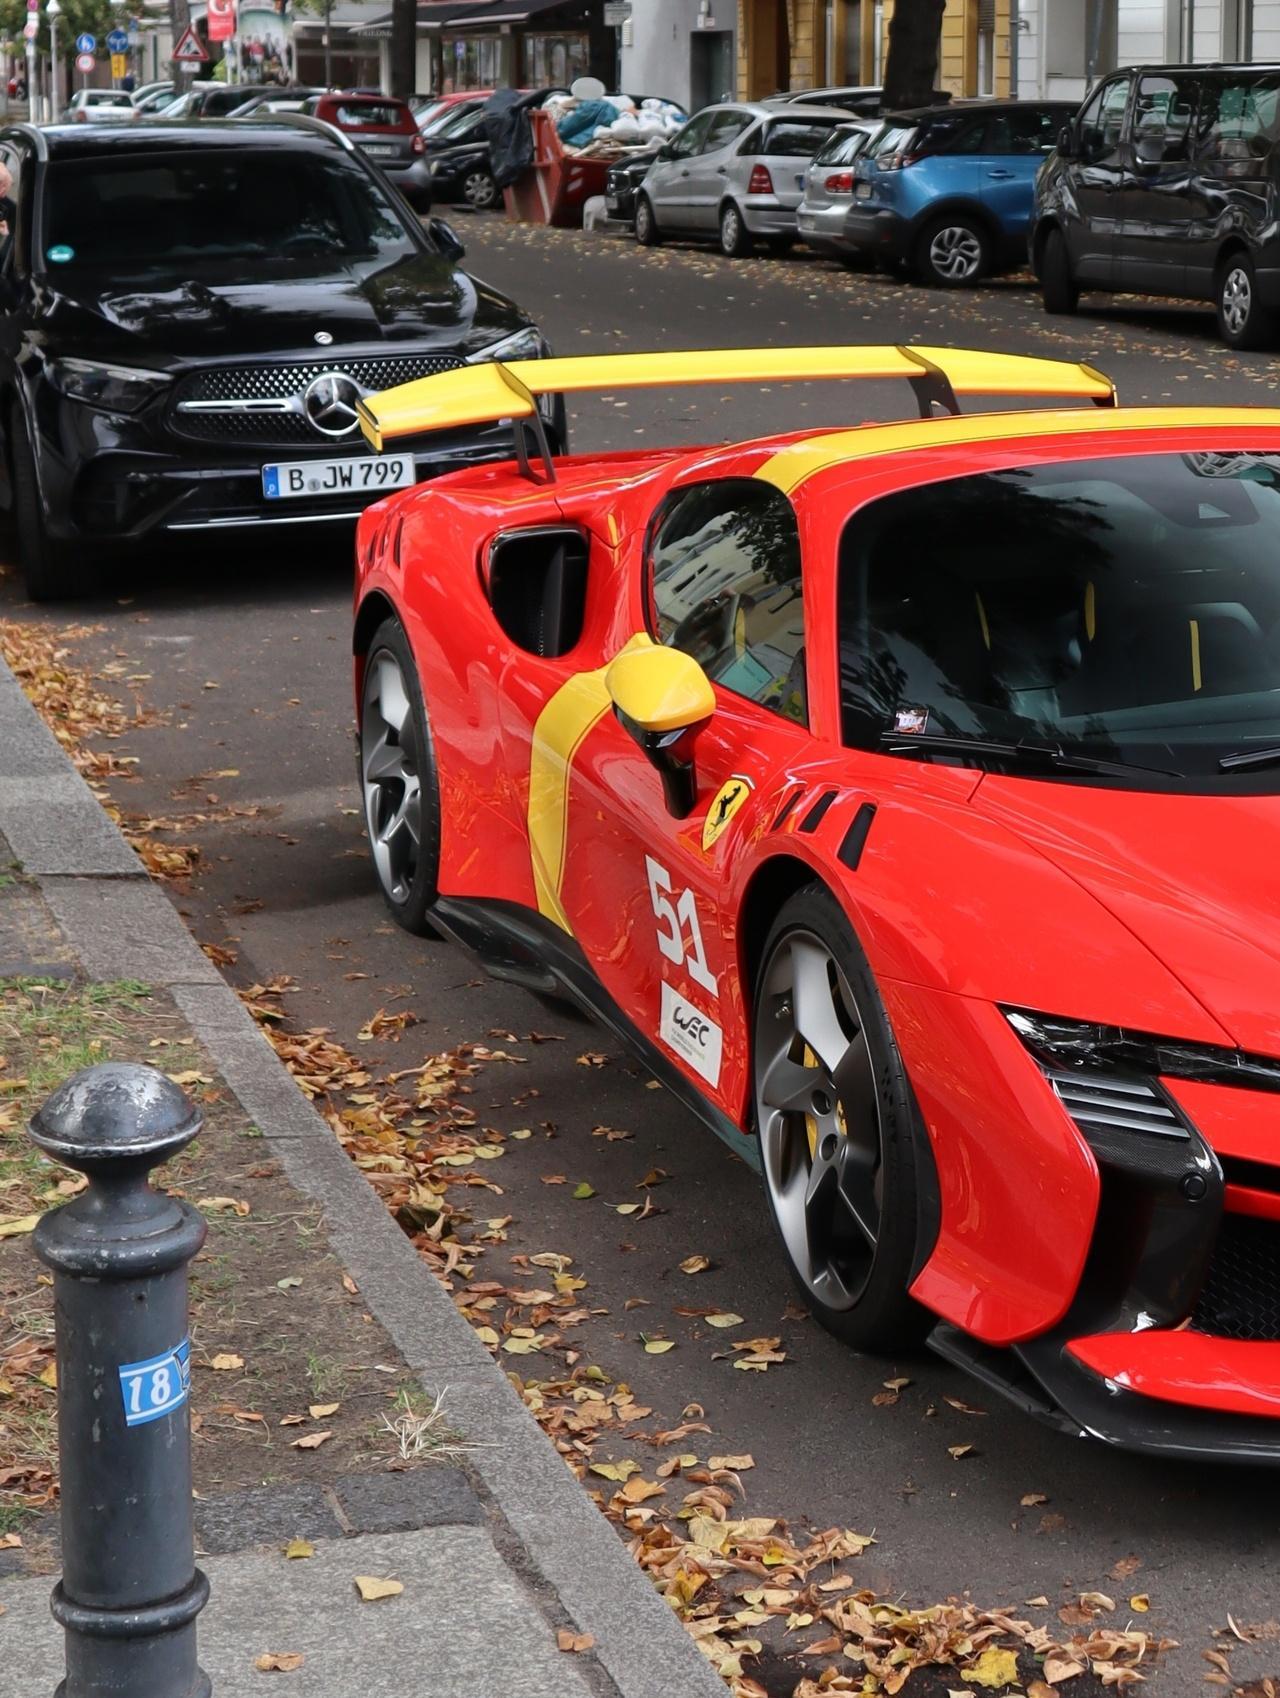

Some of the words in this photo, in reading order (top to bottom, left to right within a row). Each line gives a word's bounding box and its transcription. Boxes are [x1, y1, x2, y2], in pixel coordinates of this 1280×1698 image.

[289, 469, 304, 491] B
[323, 464, 353, 489] JW
[360, 460, 404, 486] 799
[645, 854, 720, 999] 51
[672, 1006, 710, 1047] WEC
[128, 1367, 171, 1413] 18
